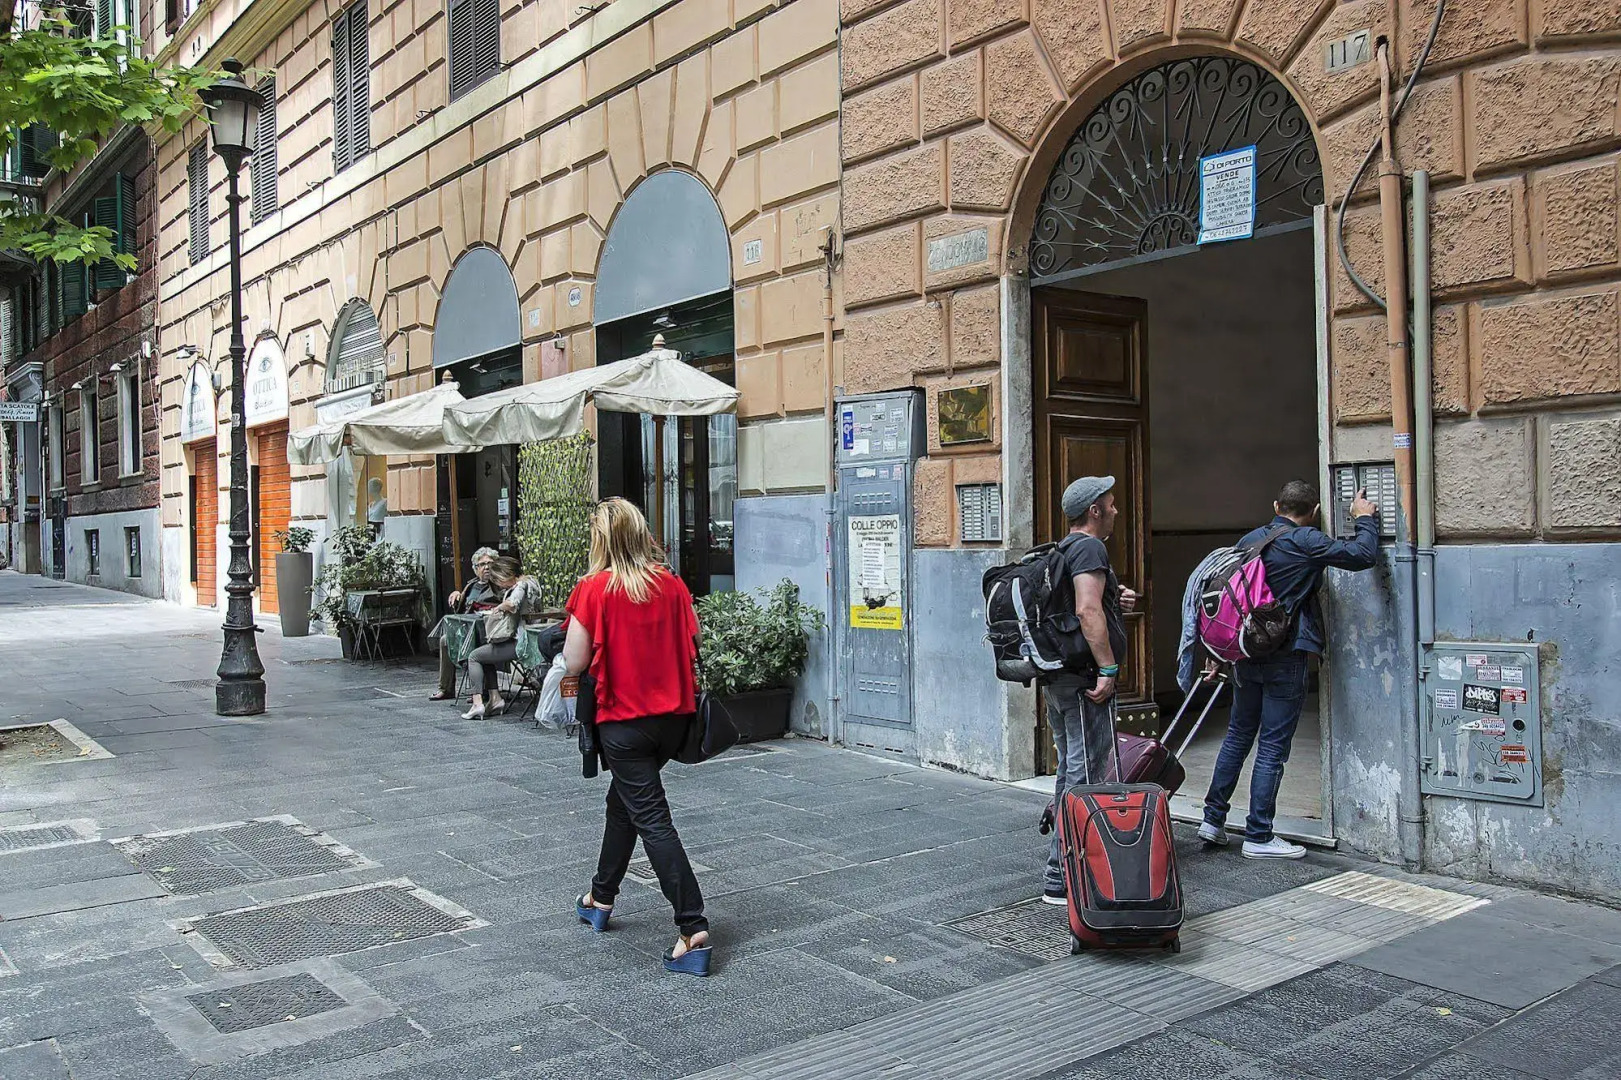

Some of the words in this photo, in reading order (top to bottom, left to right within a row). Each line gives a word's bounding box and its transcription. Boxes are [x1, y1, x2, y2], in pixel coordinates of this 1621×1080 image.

[1329, 33, 1367, 68] 117
[1225, 155, 1252, 167] PORTO
[1216, 169, 1239, 180] VENDE
[253, 376, 277, 396] OTTICA
[851, 520, 875, 531] COLLE
[876, 519, 898, 530] OPPIO
